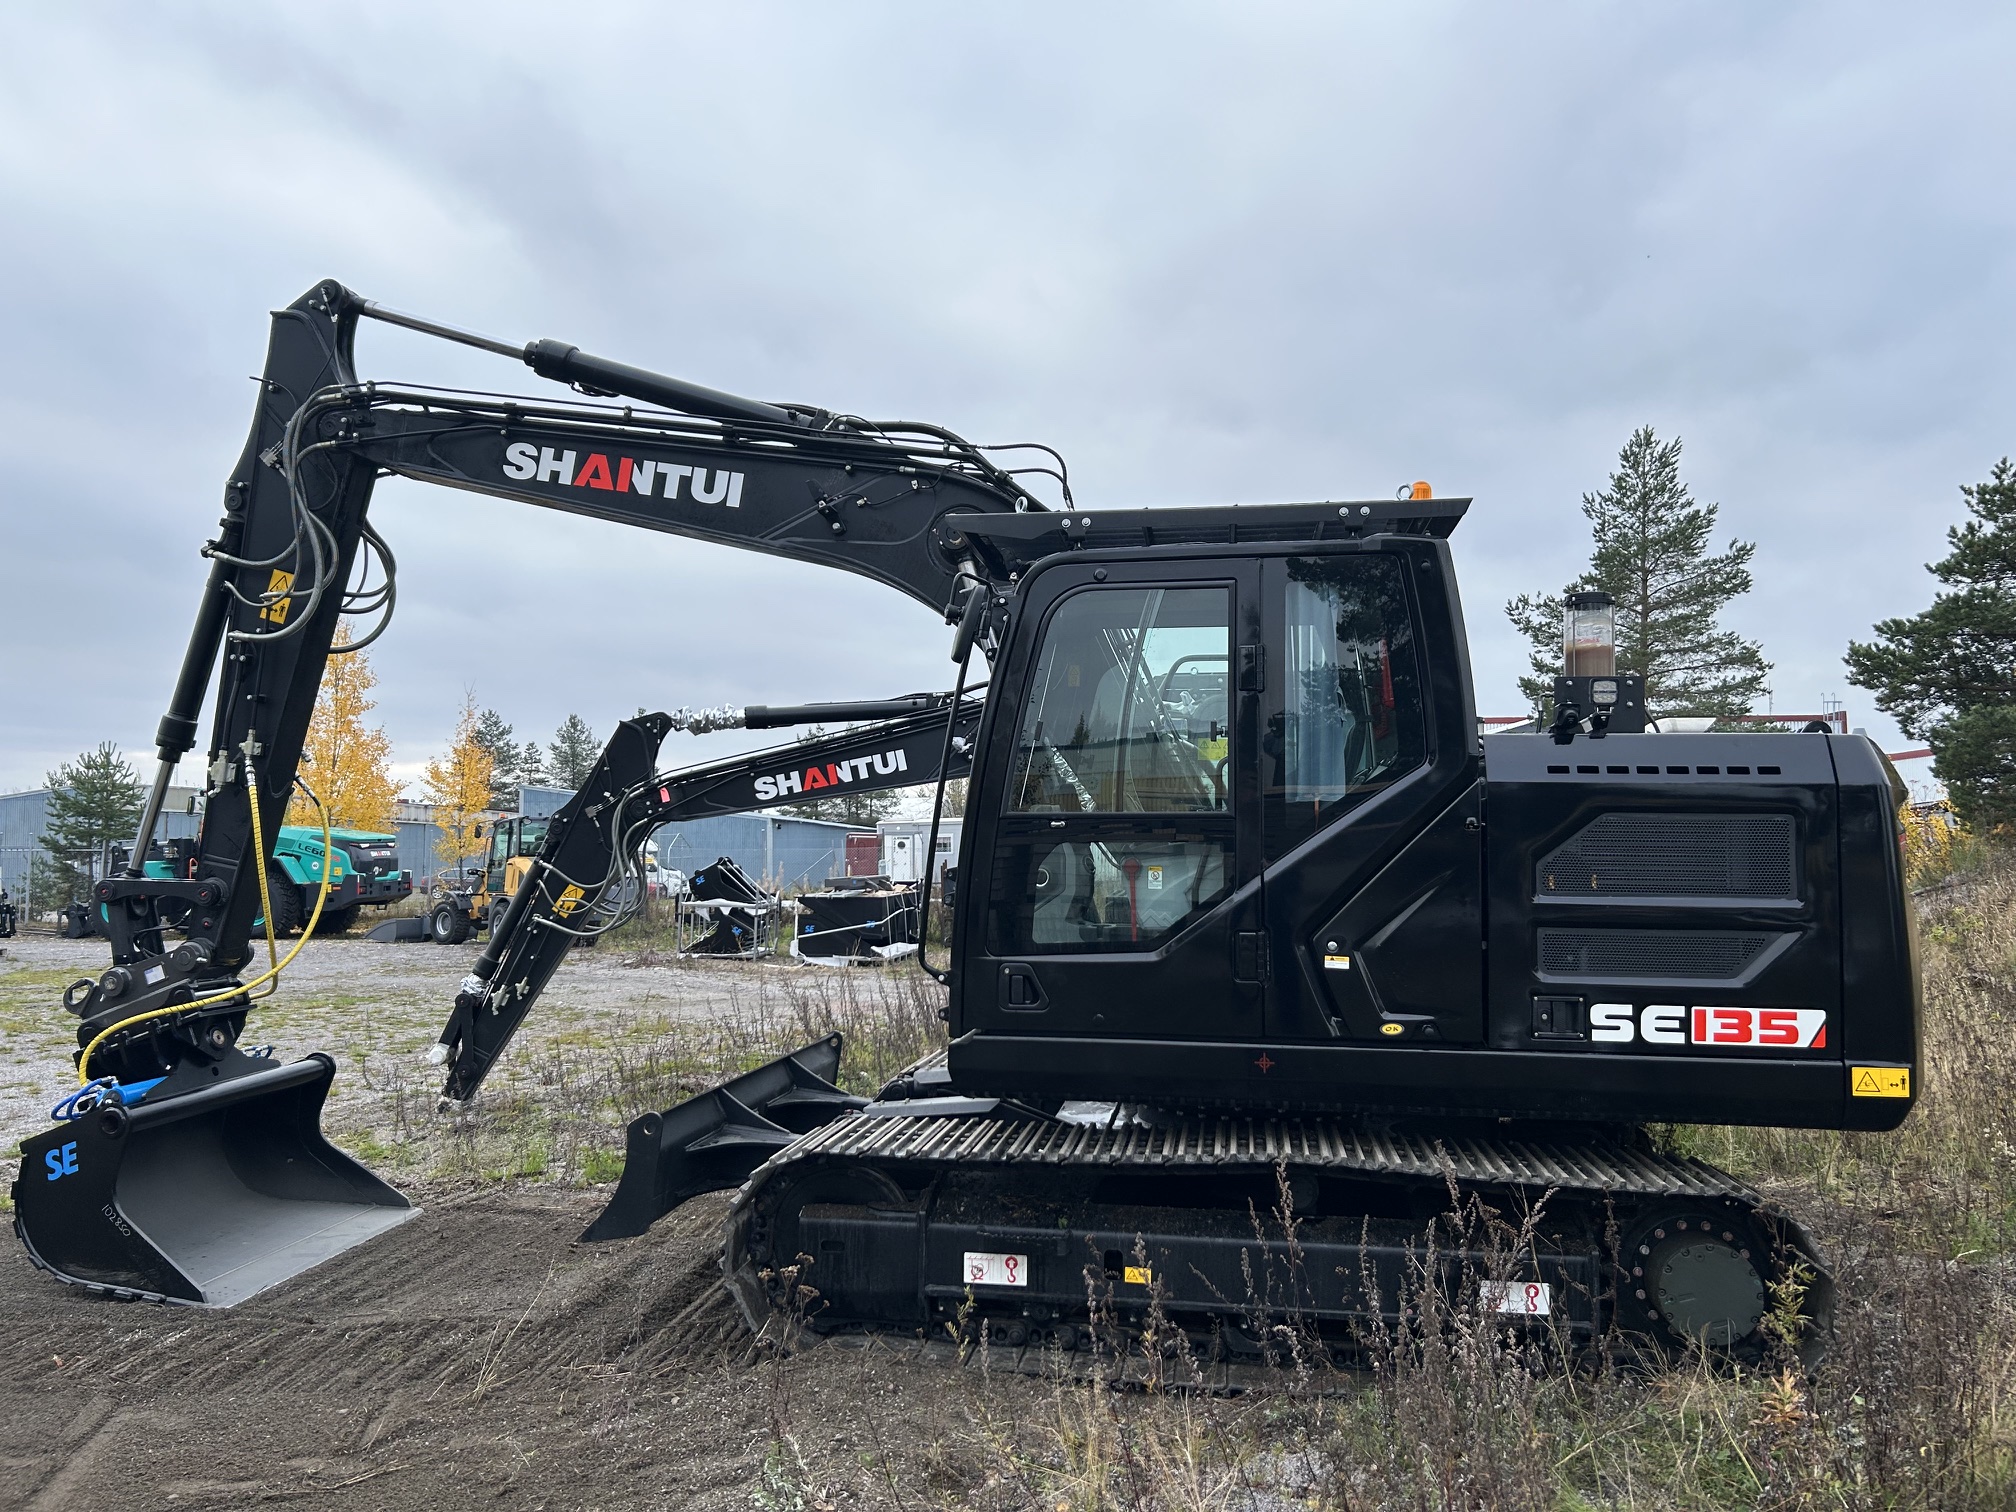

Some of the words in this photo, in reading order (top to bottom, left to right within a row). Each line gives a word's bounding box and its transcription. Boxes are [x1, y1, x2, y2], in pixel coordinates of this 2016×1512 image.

[502, 442, 745, 508] SHANTUI
[753, 748, 908, 801] SHANTUI
[695, 875, 706, 886] SE
[804, 924, 816, 933] SE
[45, 1140, 79, 1181] SE
